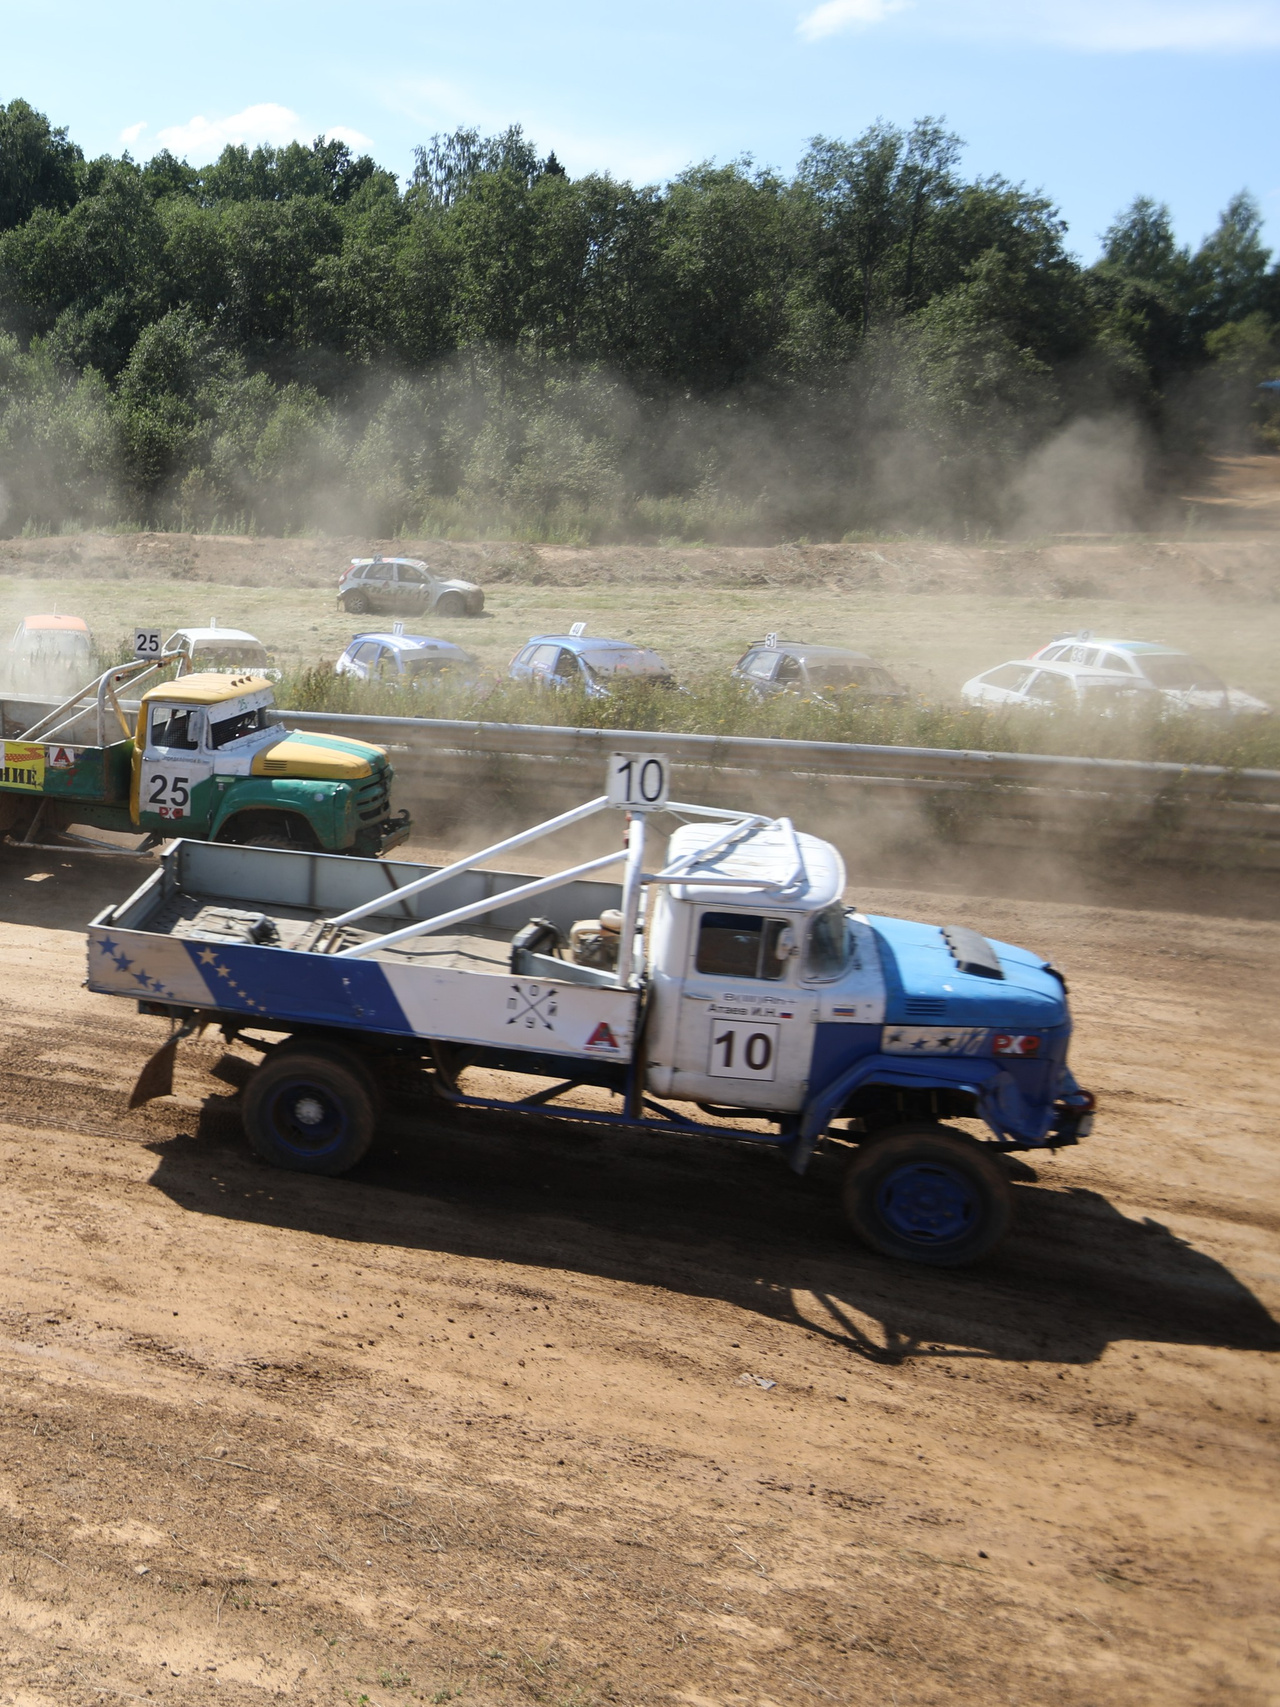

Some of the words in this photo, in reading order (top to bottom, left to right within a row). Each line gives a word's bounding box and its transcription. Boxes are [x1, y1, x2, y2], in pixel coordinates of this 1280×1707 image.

[416, 590, 431, 602] 12
[136, 633, 159, 652] 25
[767, 634, 776, 648] 51
[1071, 647, 1084, 663] 33
[617, 759, 663, 802] 10
[149, 774, 189, 807] 25
[714, 1030, 773, 1071] 10
